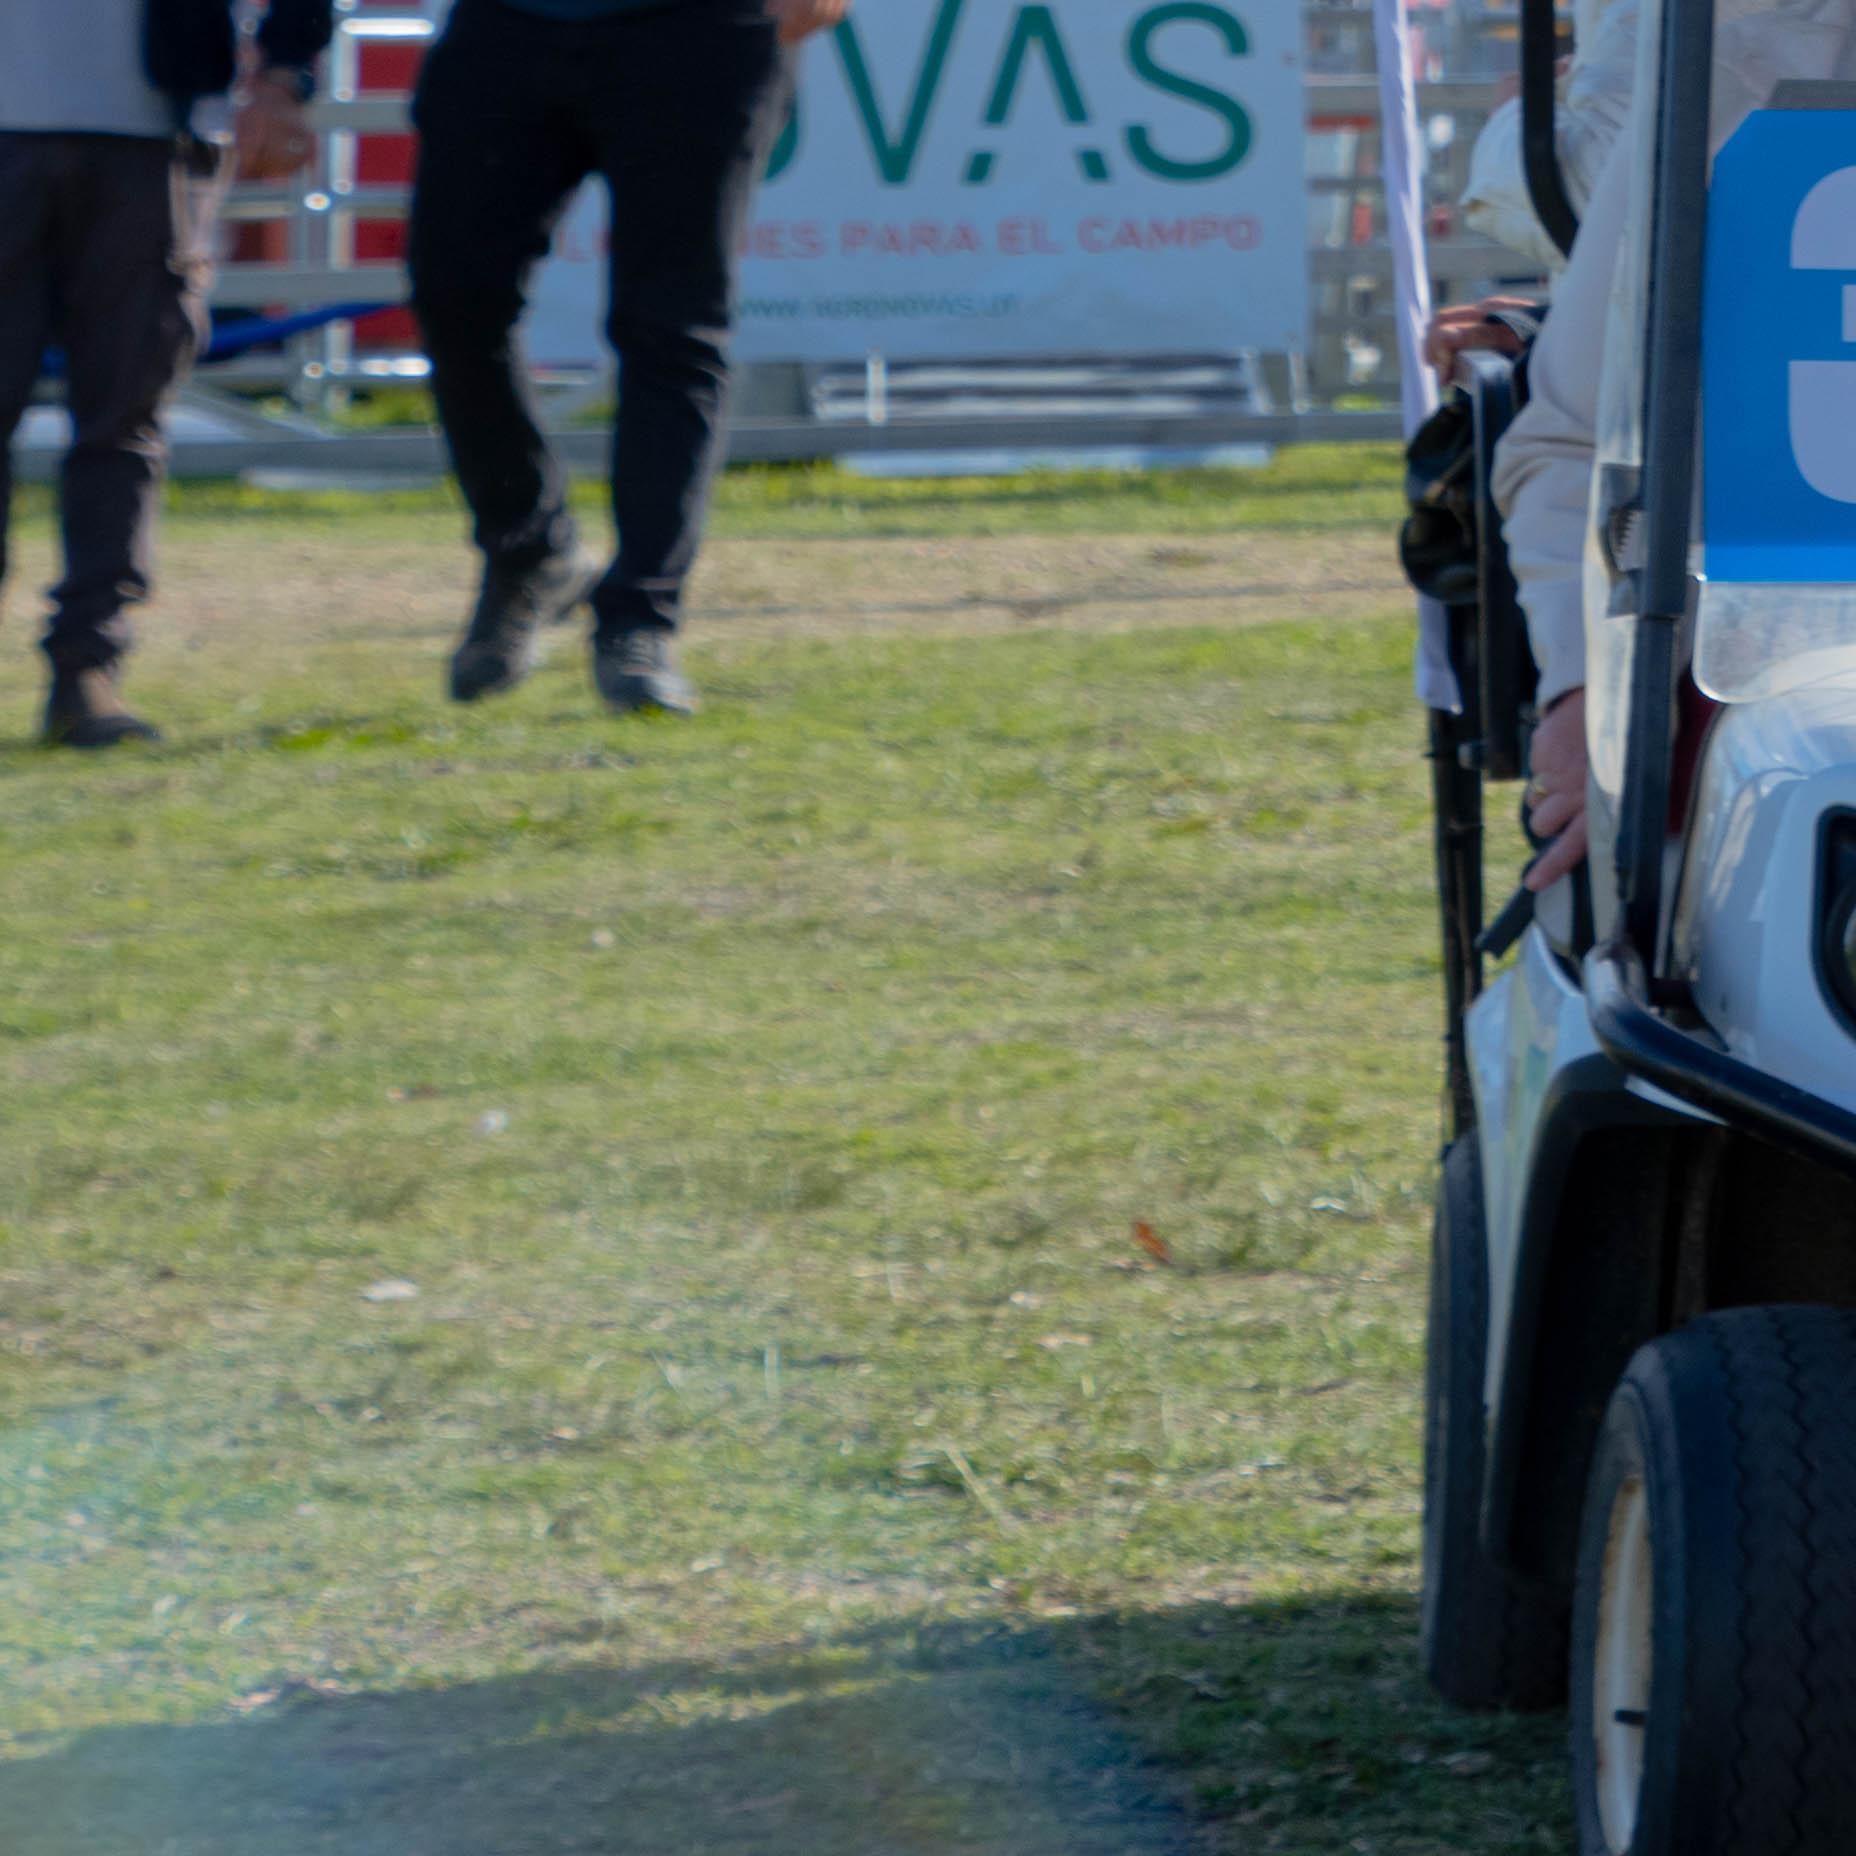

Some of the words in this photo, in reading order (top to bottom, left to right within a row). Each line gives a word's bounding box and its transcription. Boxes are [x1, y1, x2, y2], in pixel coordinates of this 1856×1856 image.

[838, 217, 979, 256] PARA
[995, 218, 1064, 256] EL
[1076, 214, 1264, 253] CAMPO
